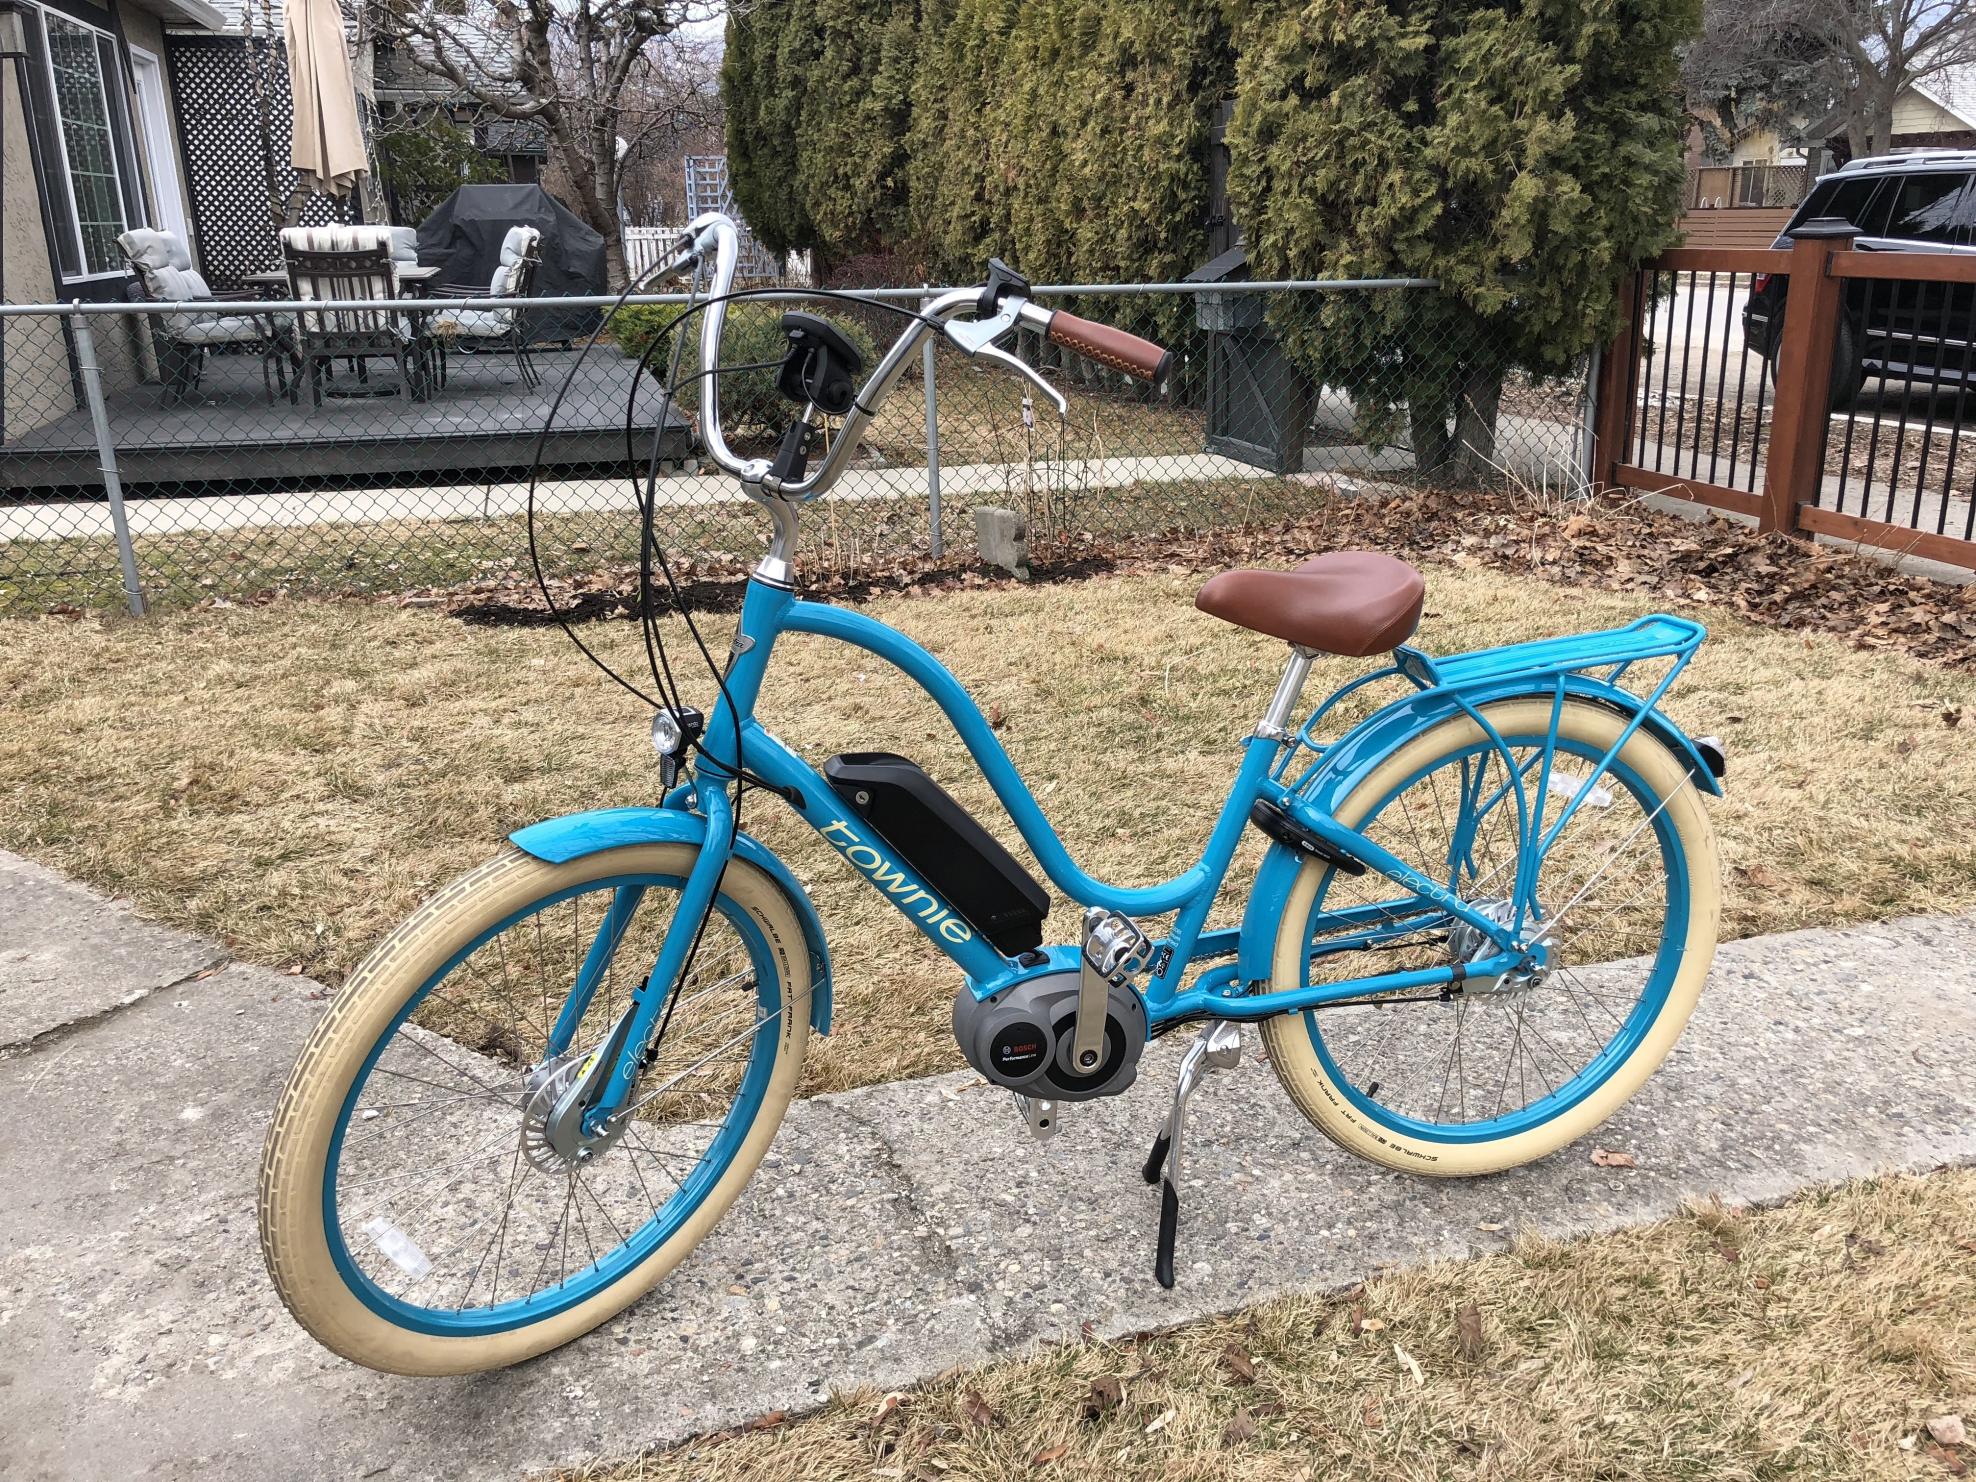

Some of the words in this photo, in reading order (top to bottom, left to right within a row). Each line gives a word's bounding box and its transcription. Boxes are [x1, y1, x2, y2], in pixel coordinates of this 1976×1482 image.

[819, 819, 972, 944] townie
[1385, 869, 1470, 912] electra
[750, 906, 782, 944] SCHWALBE
[1013, 1043, 1037, 1053] BOSCH
[1389, 1143, 1439, 1162] SCHWALBE
